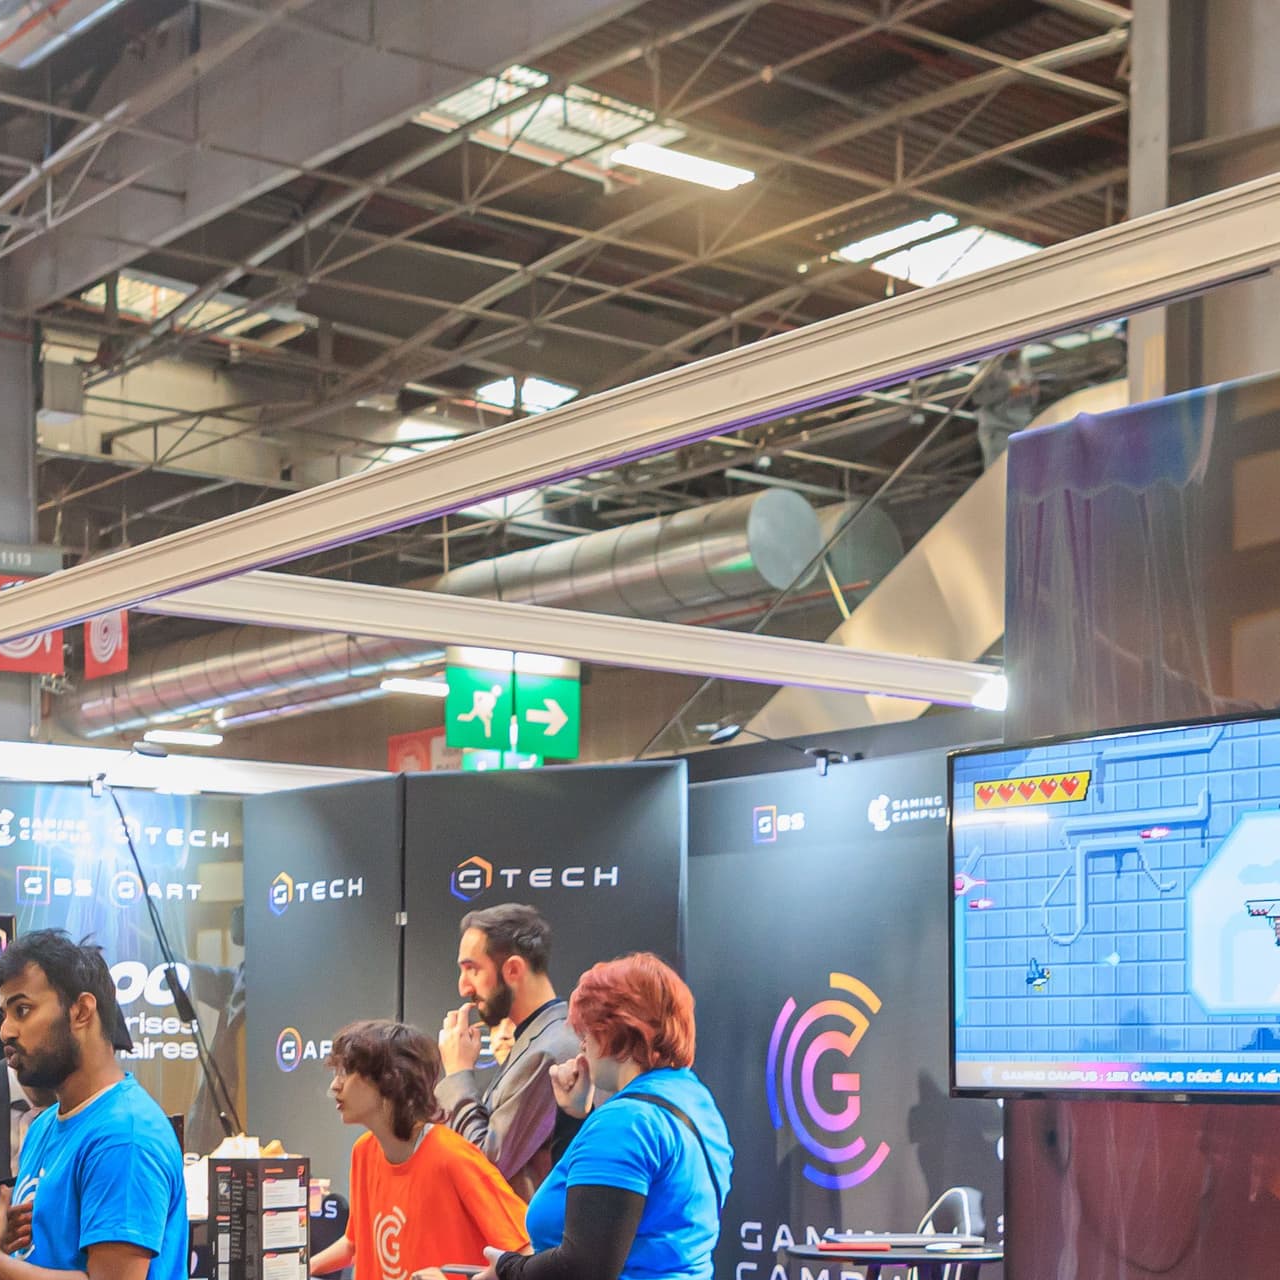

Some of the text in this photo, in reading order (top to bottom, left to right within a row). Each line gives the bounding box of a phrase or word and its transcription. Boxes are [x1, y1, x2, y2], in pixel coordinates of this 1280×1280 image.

[891, 795, 943, 811] GAMING
[891, 807, 946, 823] CAMPUS
[144, 826, 231, 849] TECH
[499, 865, 619, 889] TECH
[147, 882, 203, 901] ART
[295, 876, 364, 902] TECH
[1131, 1072, 1184, 1083] CAMPUS
[1225, 1071, 1254, 1083] AUX
